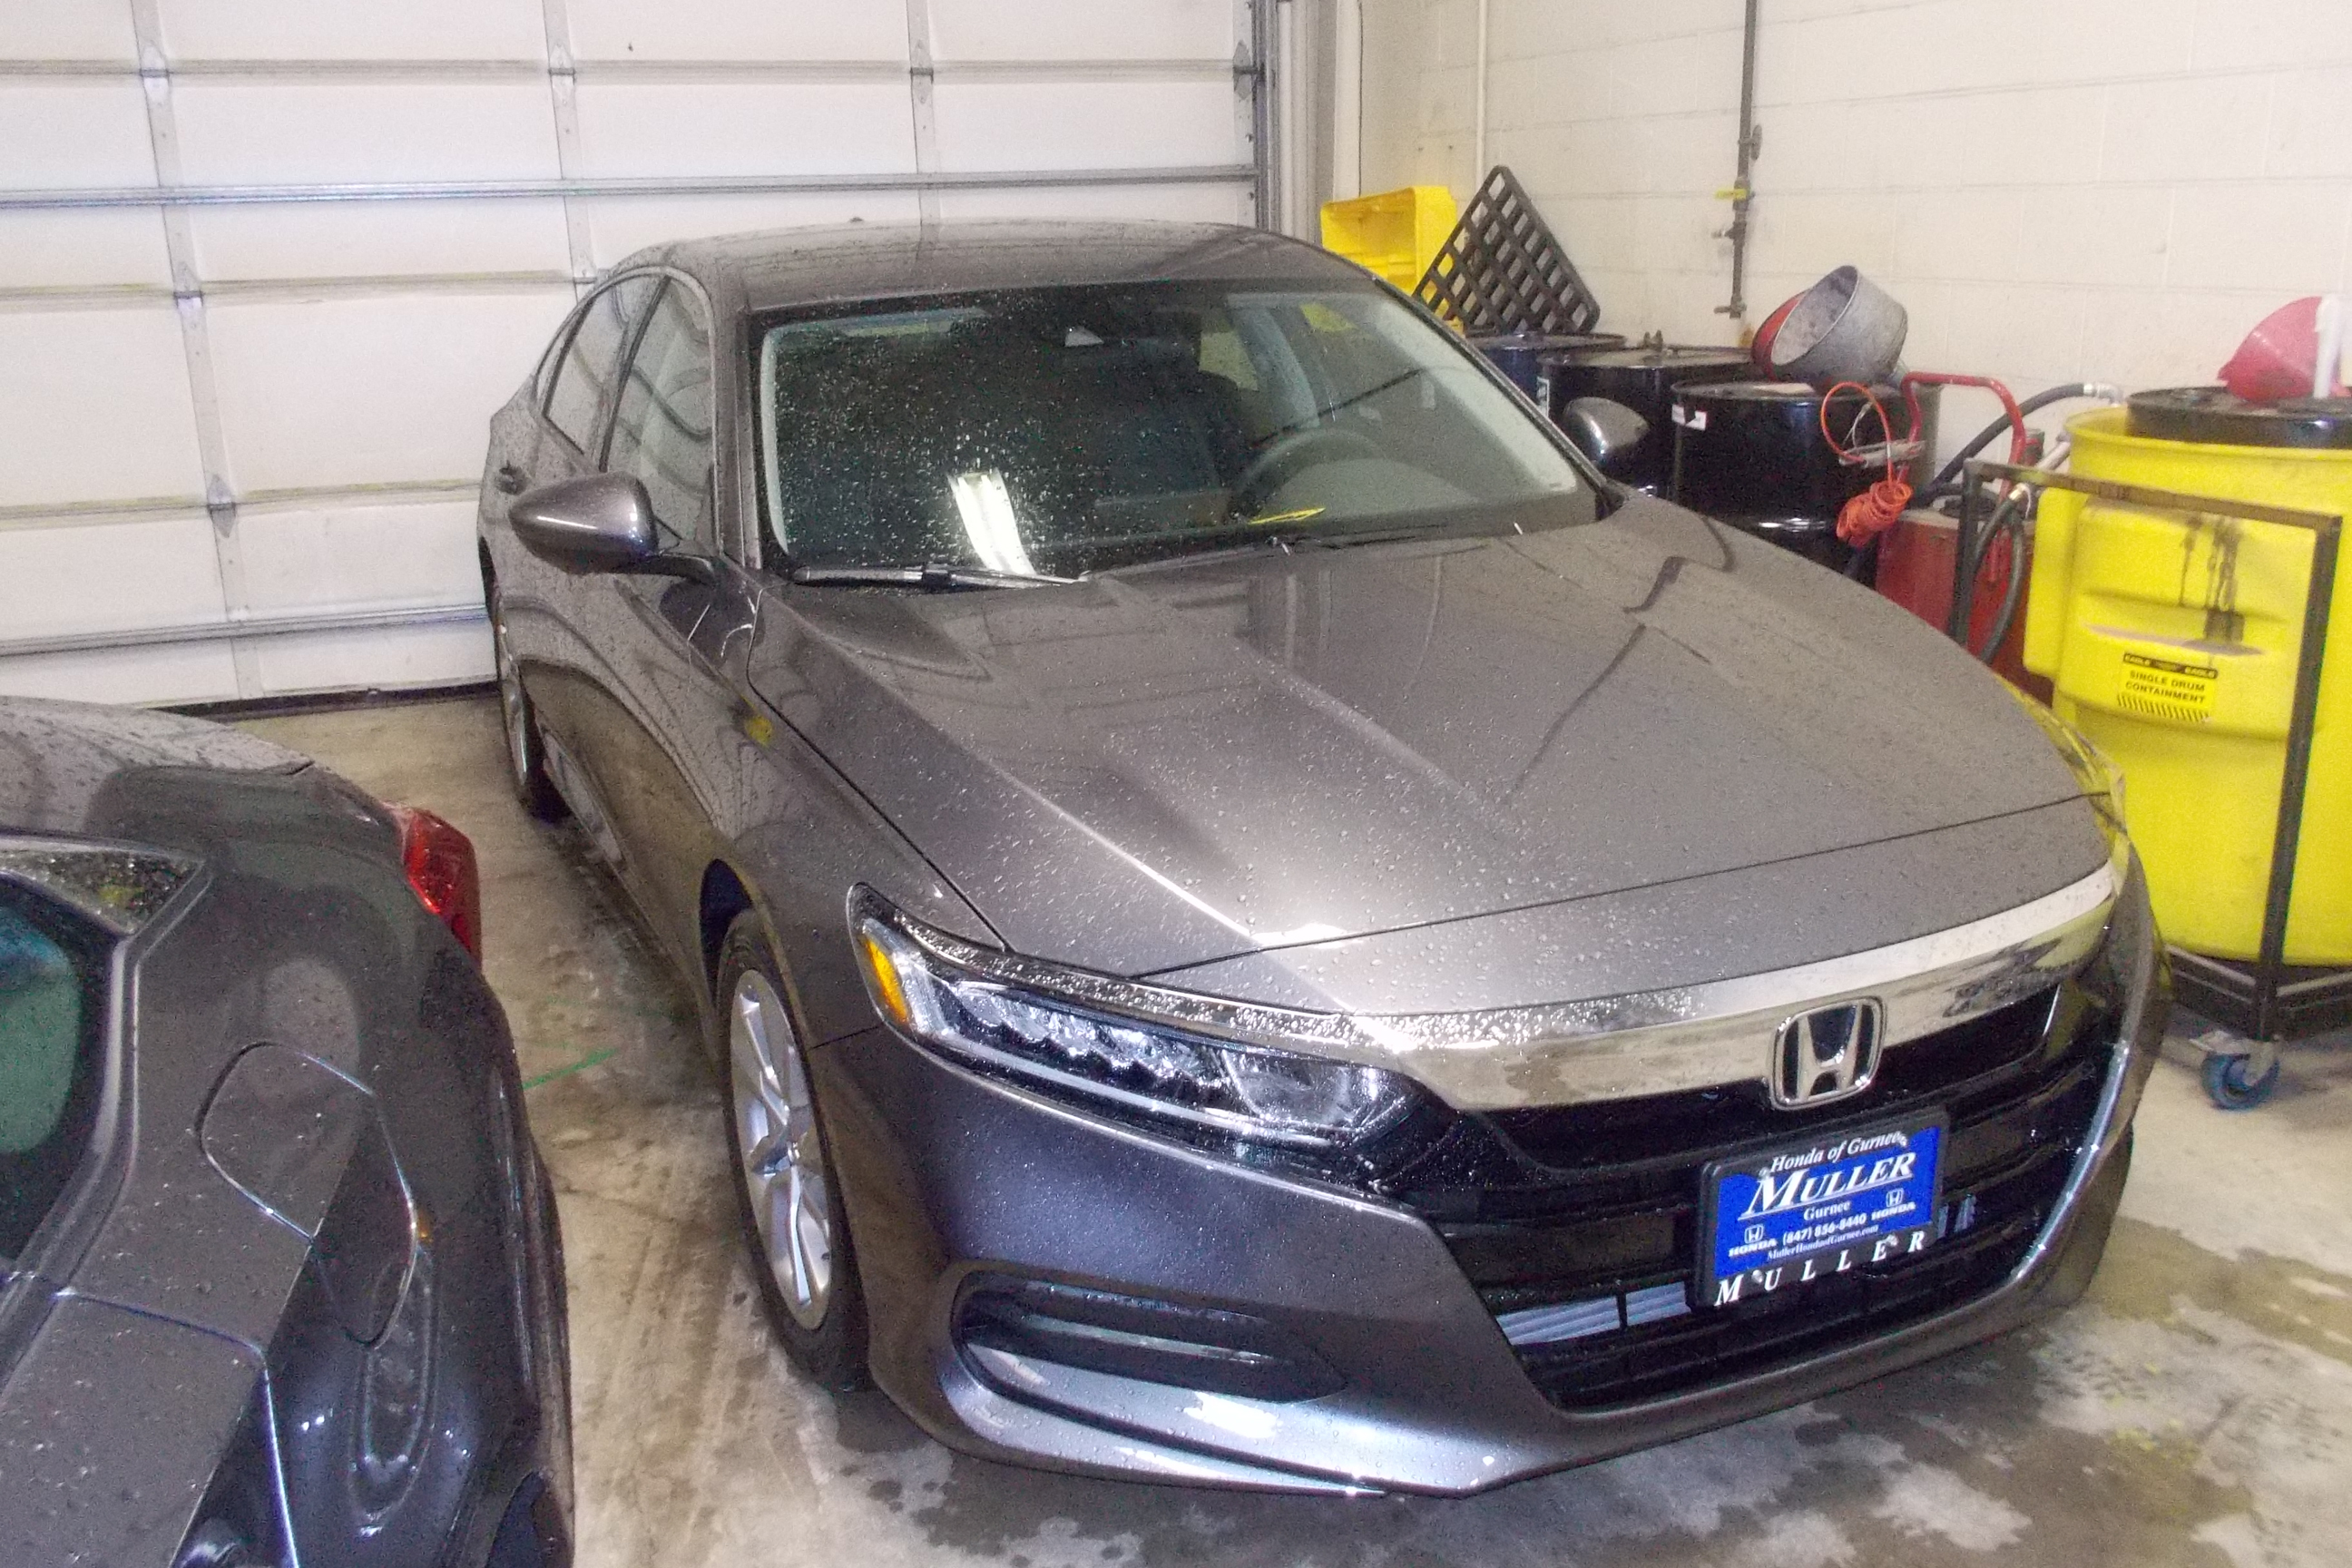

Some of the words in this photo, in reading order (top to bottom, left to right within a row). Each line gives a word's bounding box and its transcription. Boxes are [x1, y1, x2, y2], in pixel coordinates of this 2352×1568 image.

[2130, 670, 2167, 683] SINGLE
[2171, 680, 2205, 691] DRUM
[2125, 681, 2205, 703] CONTAINMENT
[1770, 1148, 1823, 1173] Honda
[1827, 1140, 1847, 1161] of
[1803, 1200, 1851, 1221] Gurnee
[1871, 1201, 1916, 1222] HONDA
[1782, 1228, 1813, 1246] (847)
[1728, 1238, 1777, 1258] HONDA
